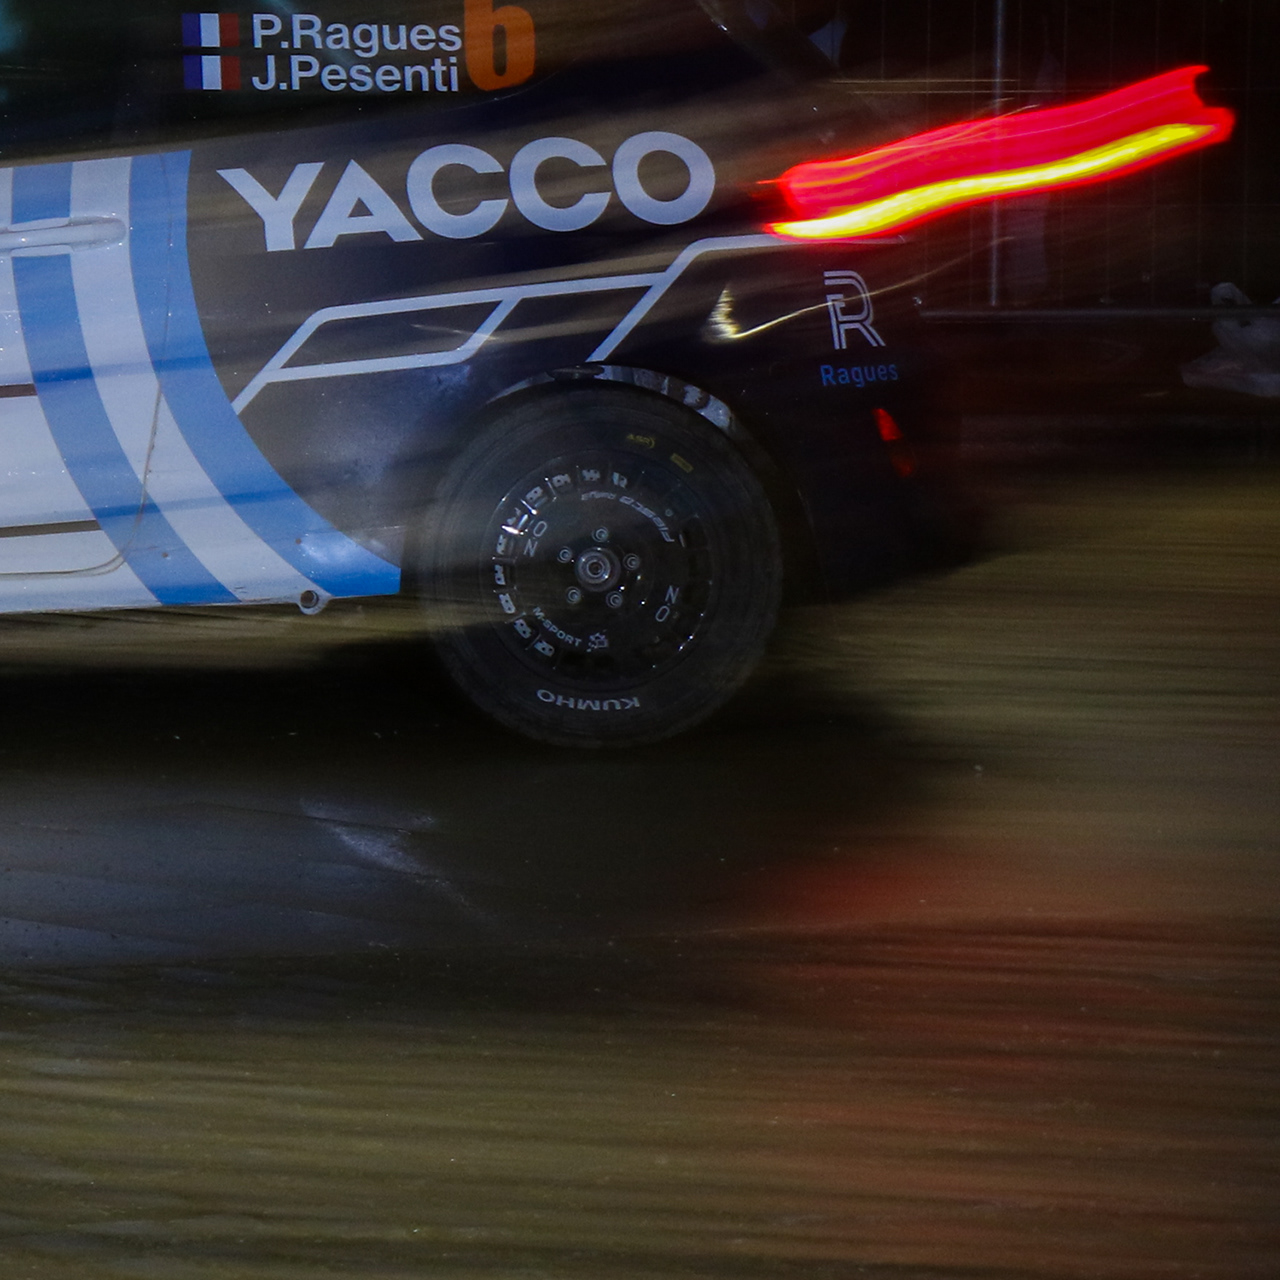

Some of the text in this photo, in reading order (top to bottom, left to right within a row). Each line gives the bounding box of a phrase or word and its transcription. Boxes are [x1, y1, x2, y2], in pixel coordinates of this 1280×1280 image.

[252, 13, 462, 58] P.Ragues
[252, 55, 459, 93] J.Pesenti
[217, 131, 715, 252] YACCO
[820, 363, 899, 388] Ragues
[532, 606, 583, 648] M-SPORT
[536, 688, 641, 712] KUMHO
